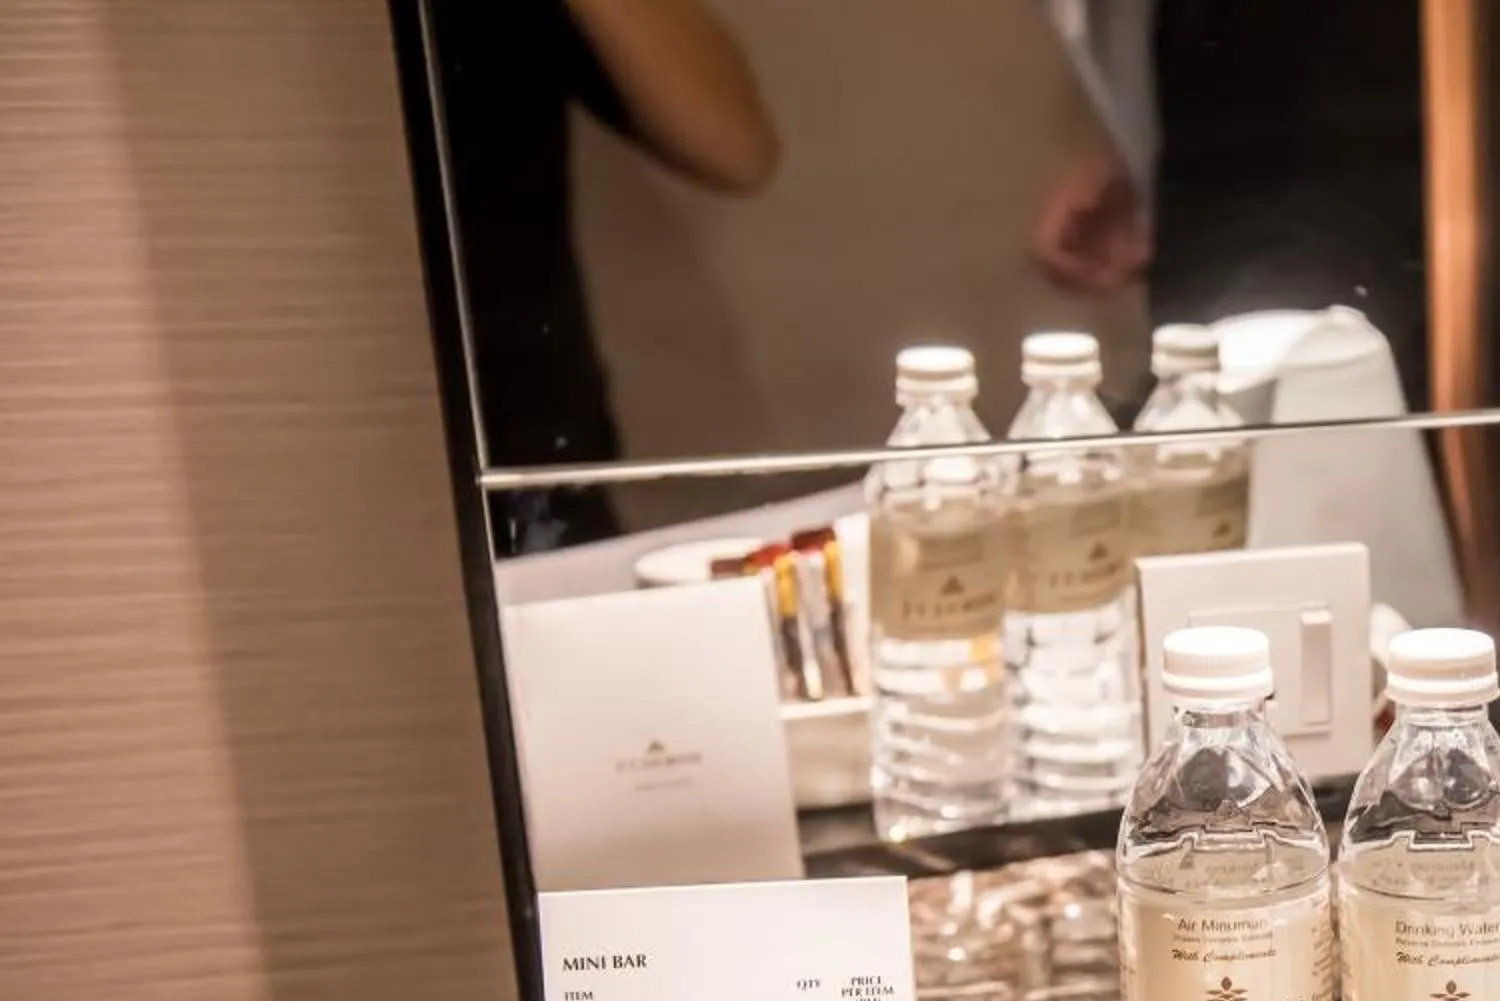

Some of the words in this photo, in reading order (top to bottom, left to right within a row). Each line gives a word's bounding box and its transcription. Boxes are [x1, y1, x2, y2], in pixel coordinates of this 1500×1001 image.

[1178, 918, 1197, 931] Air
[1395, 921, 1455, 937] Drinking
[1459, 921, 1500, 936] Water
[563, 956, 607, 971] MINI
[612, 954, 648, 969] BAR
[797, 979, 820, 991] QTY
[851, 976, 881, 986] PRICE
[564, 991, 594, 1001] ITEM
